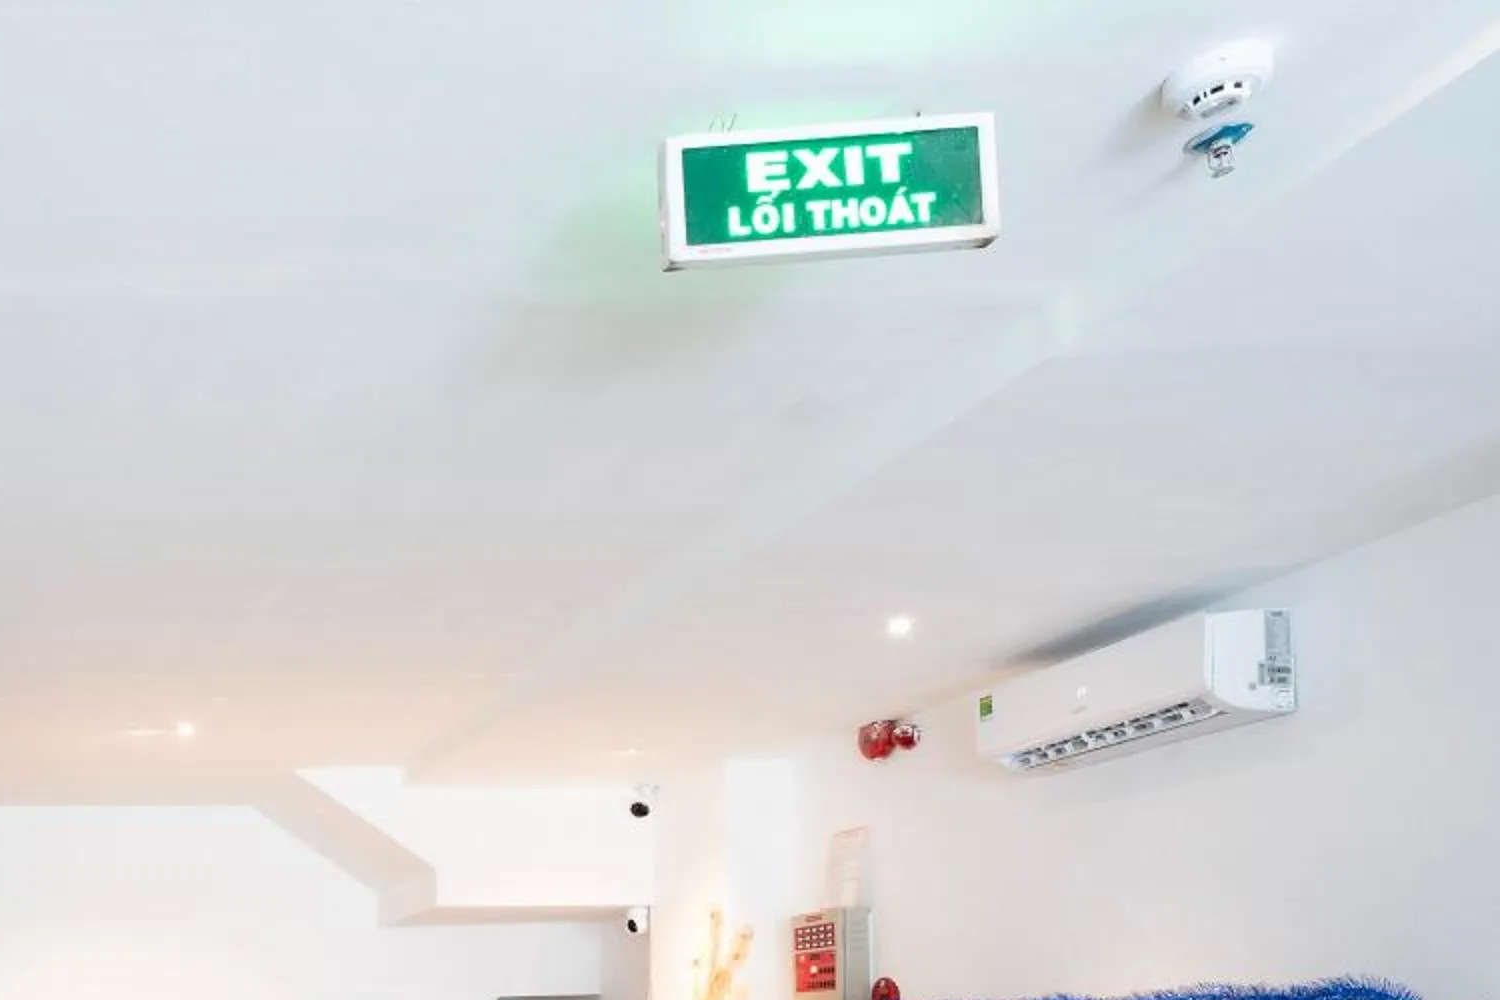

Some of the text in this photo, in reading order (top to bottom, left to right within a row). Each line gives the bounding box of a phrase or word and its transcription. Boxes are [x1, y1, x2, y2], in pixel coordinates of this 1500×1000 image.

[745, 142, 912, 192] EXIT
[727, 187, 937, 236] LỐI THOÁT
